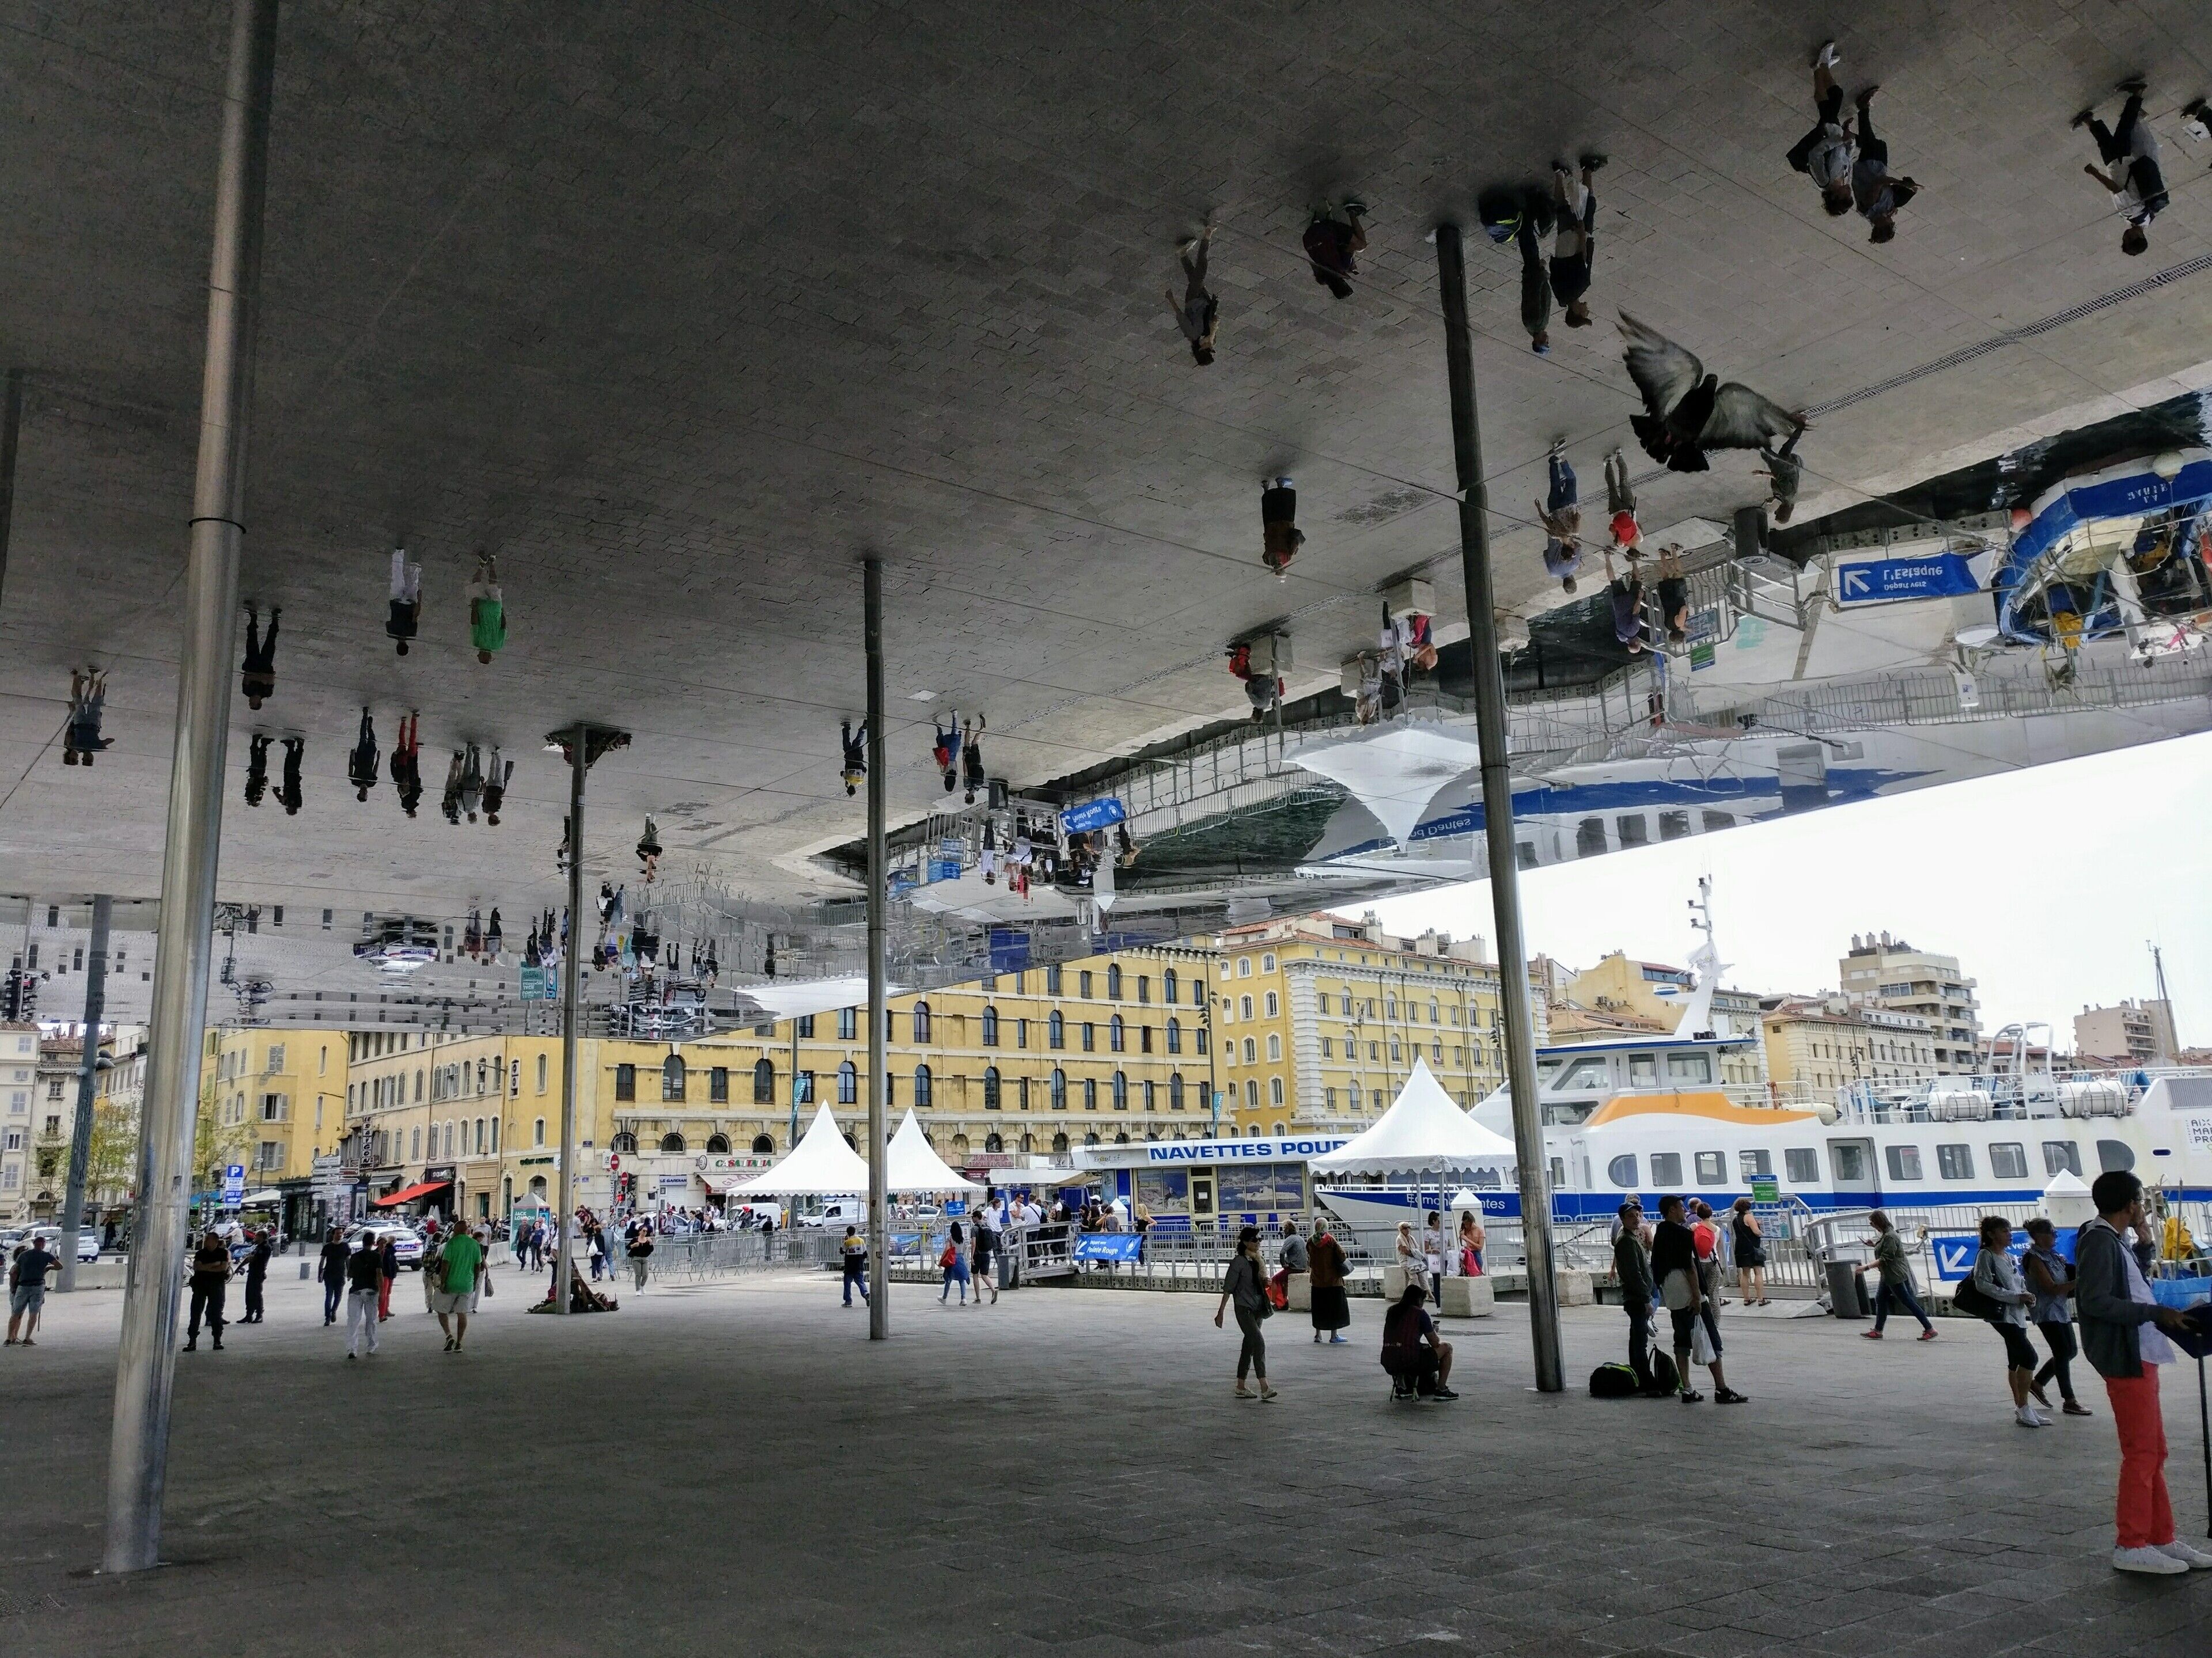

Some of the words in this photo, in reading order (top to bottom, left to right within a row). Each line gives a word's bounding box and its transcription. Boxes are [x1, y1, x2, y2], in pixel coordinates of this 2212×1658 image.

[1150, 1143, 1272, 1160] NAVETTES
[715, 1159, 741, 1167] CASA
[743, 1159, 772, 1167] ITALIA
[231, 1166, 240, 1177] P
[1101, 1246, 1119, 1255] Rouge
